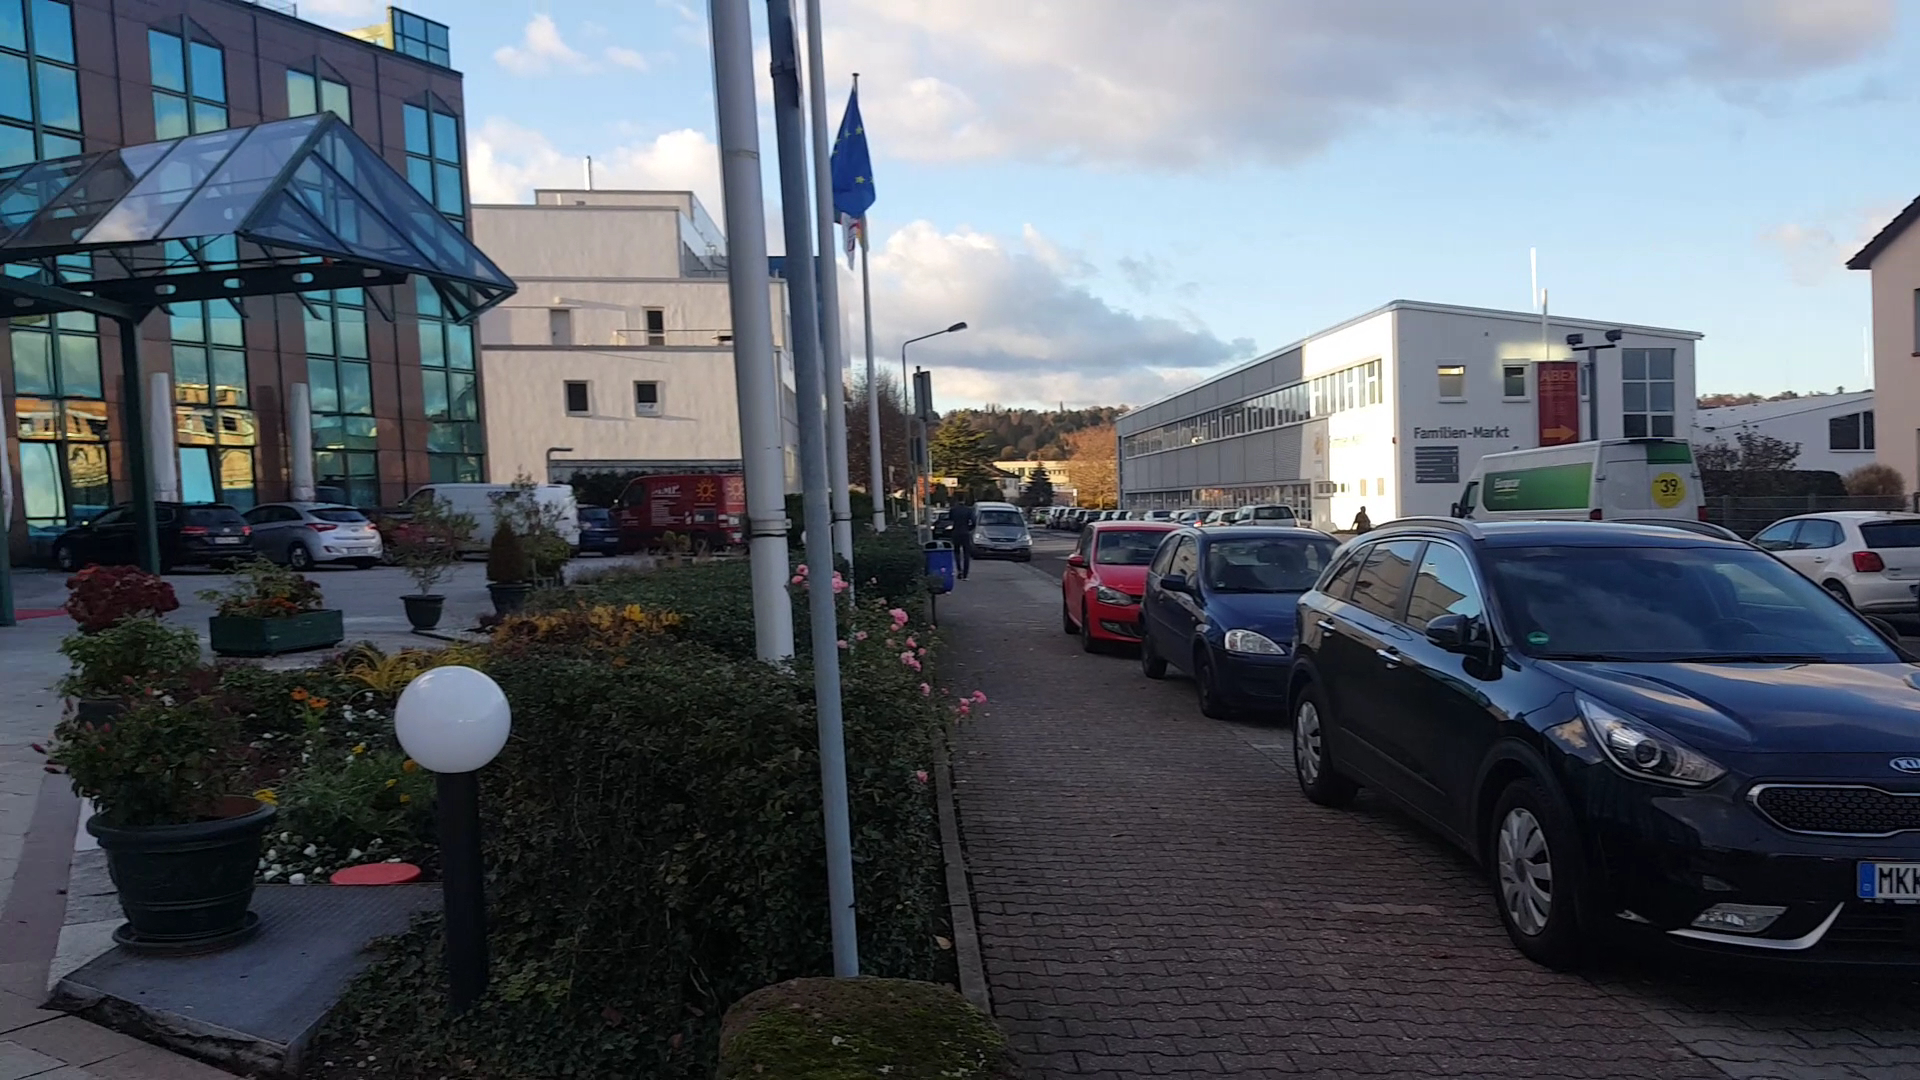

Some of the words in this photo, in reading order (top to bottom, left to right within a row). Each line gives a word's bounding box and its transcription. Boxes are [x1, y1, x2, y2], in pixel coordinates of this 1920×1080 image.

[1540, 370, 1576, 381] ABEX
[1413, 426, 1509, 439] Familien-Markt
[1660, 478, 1678, 493] 39
